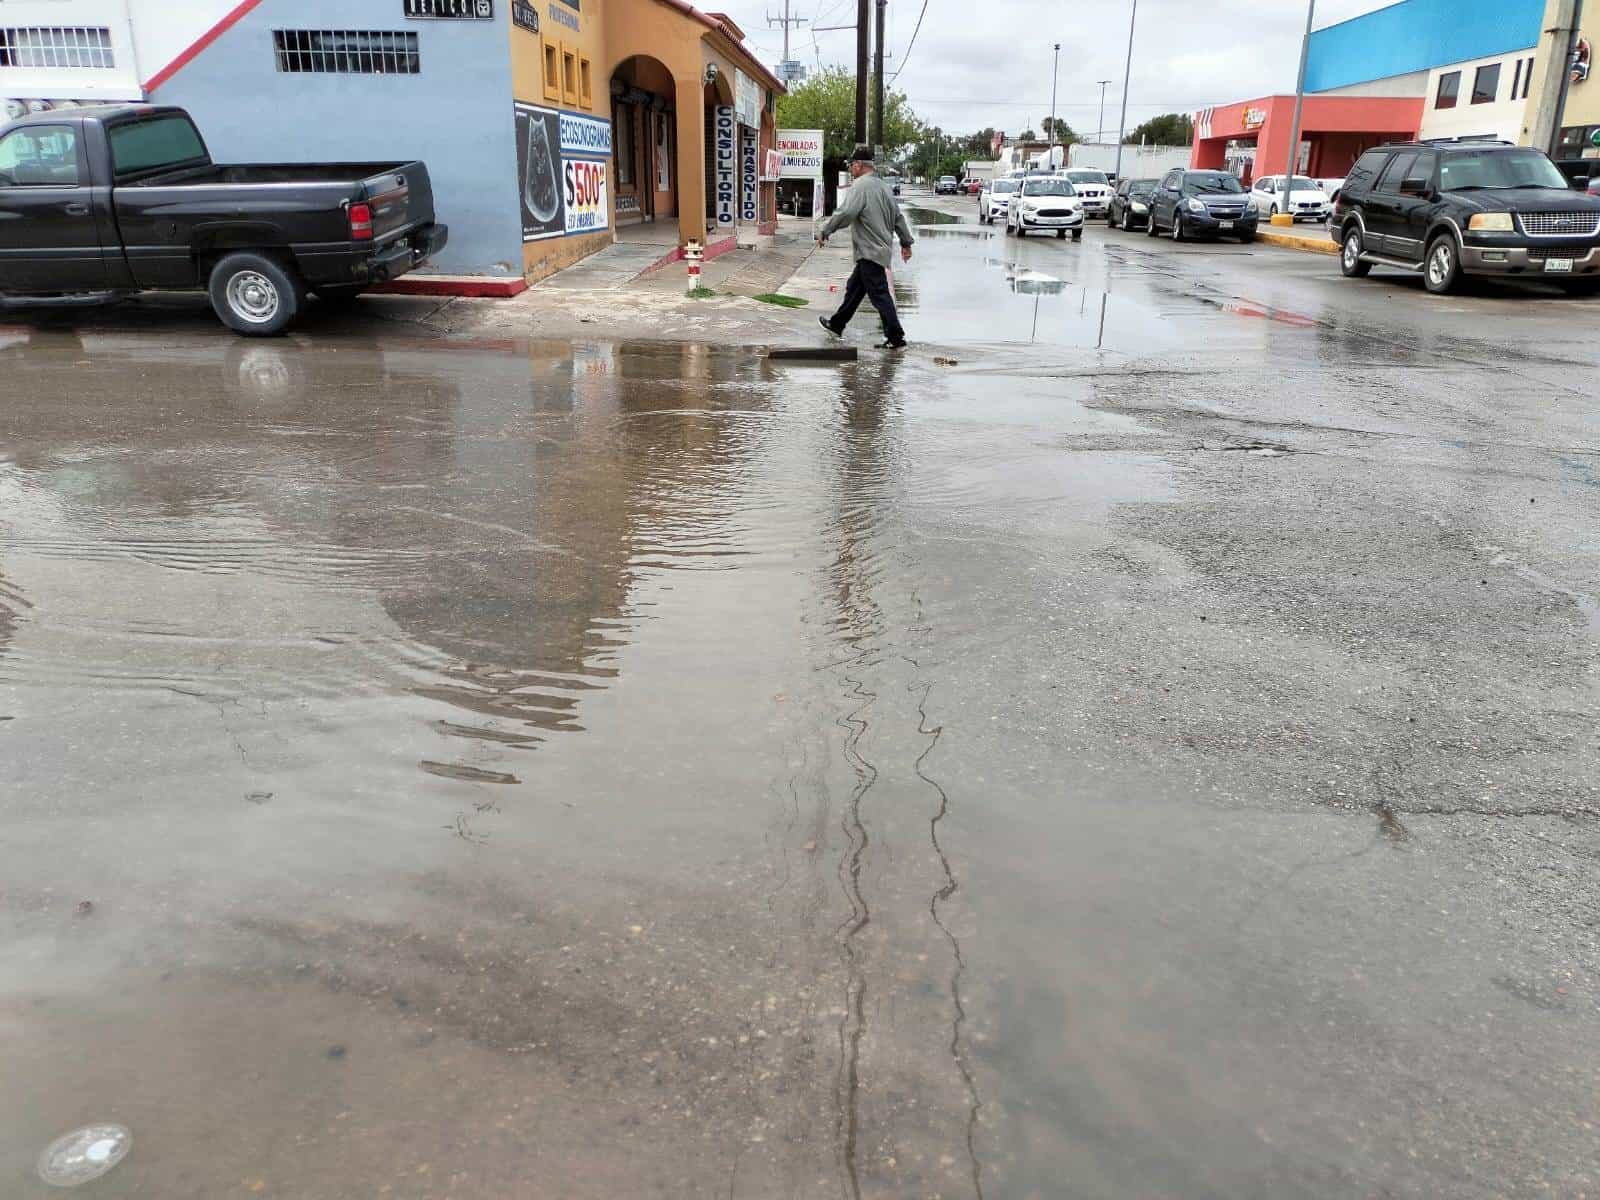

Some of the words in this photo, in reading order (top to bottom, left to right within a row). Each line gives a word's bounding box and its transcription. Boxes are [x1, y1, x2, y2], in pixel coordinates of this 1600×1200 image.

[718, 107, 732, 222] CONSULTORIO
[744, 125, 755, 219] LTRASONIDO
[777, 140, 817, 150] ENCHILADAS
